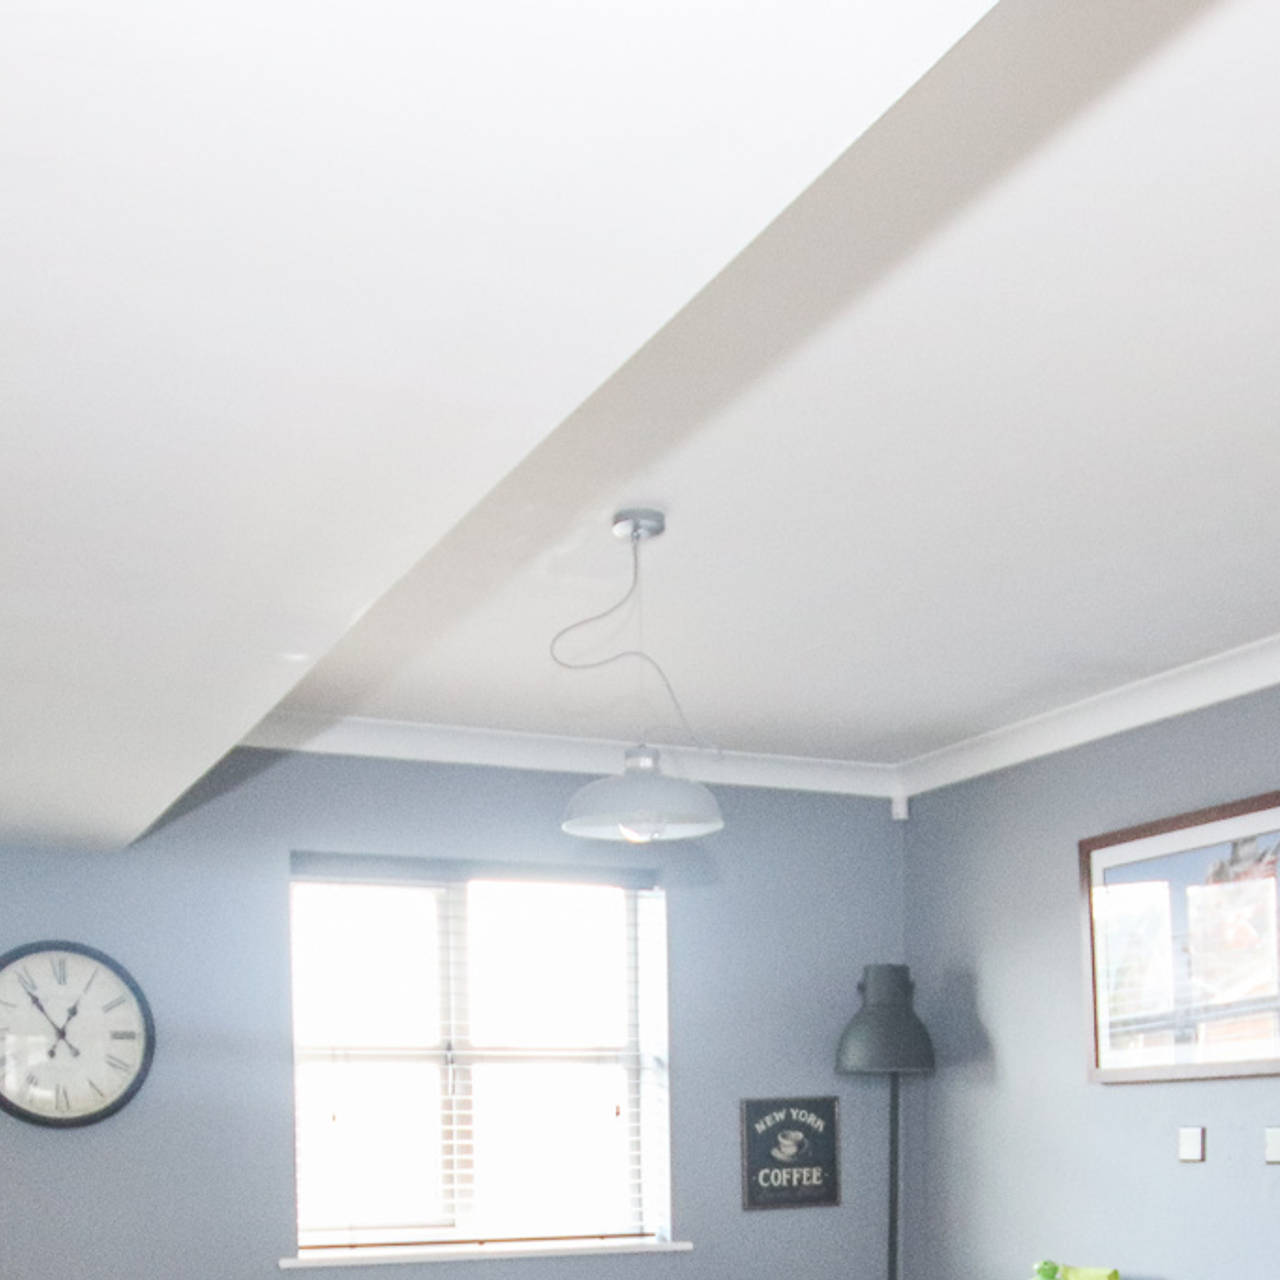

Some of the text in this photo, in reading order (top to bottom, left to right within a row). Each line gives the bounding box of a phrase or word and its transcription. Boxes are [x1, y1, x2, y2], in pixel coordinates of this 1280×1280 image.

[754, 1107, 825, 1134] NEW YORK
[758, 1166, 823, 1187] COFFEE
